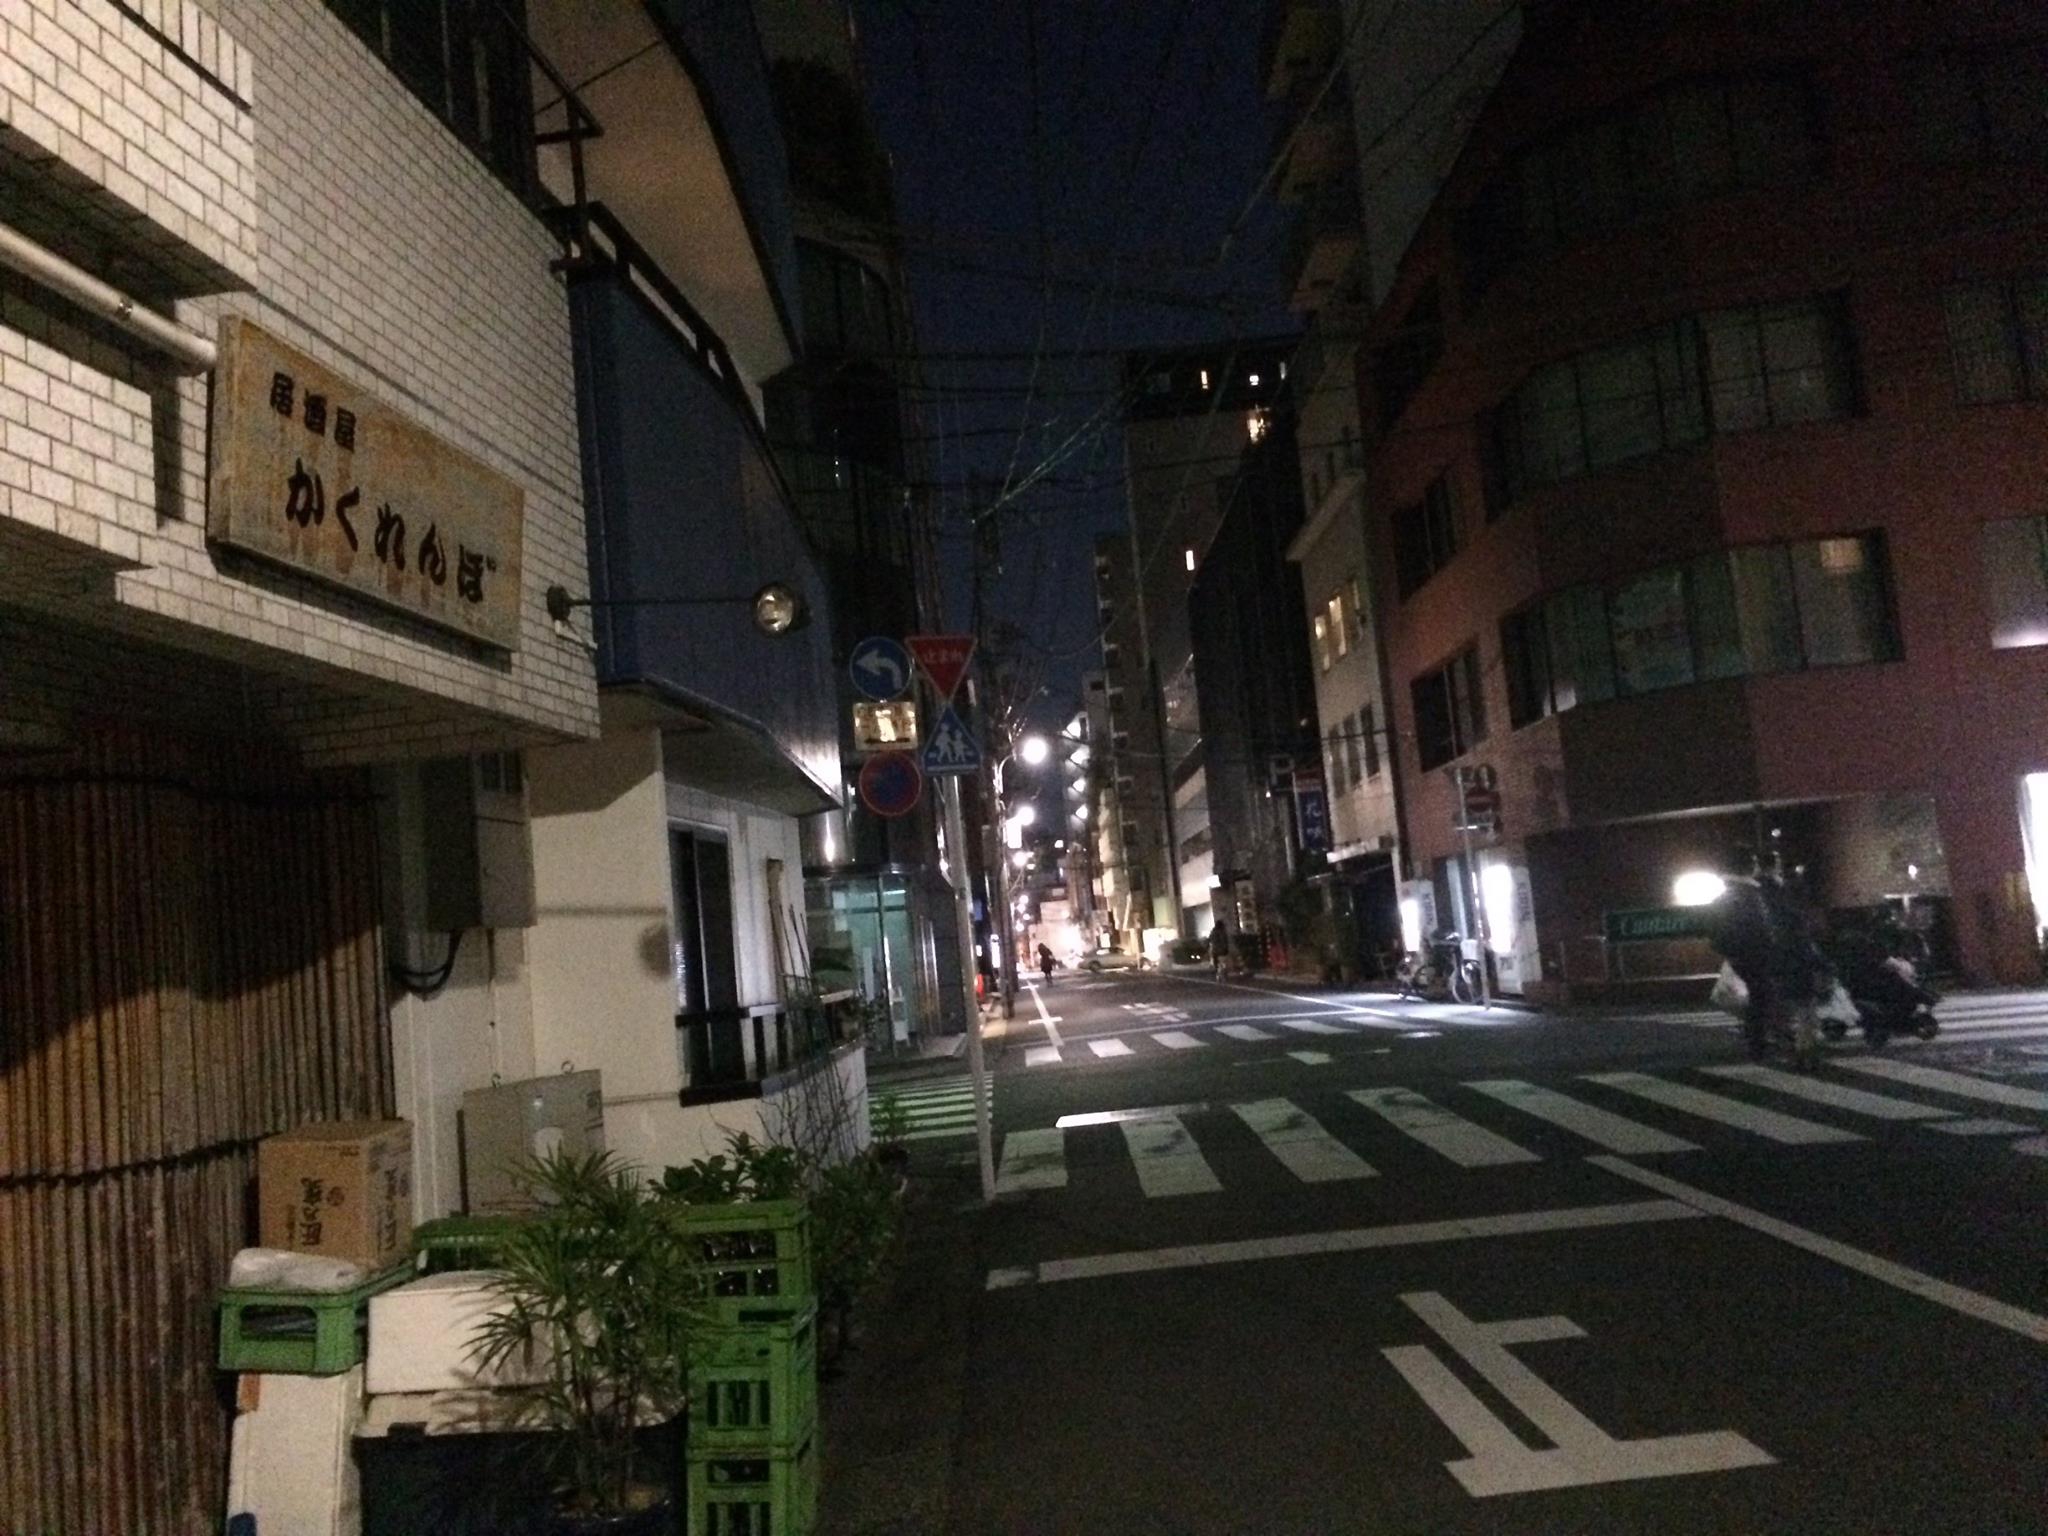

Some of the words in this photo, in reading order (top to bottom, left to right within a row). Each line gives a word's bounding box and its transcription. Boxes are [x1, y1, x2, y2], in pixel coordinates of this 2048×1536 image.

[285, 457, 497, 604] かくれんぼ
[924, 649, 964, 664] 止まれ
